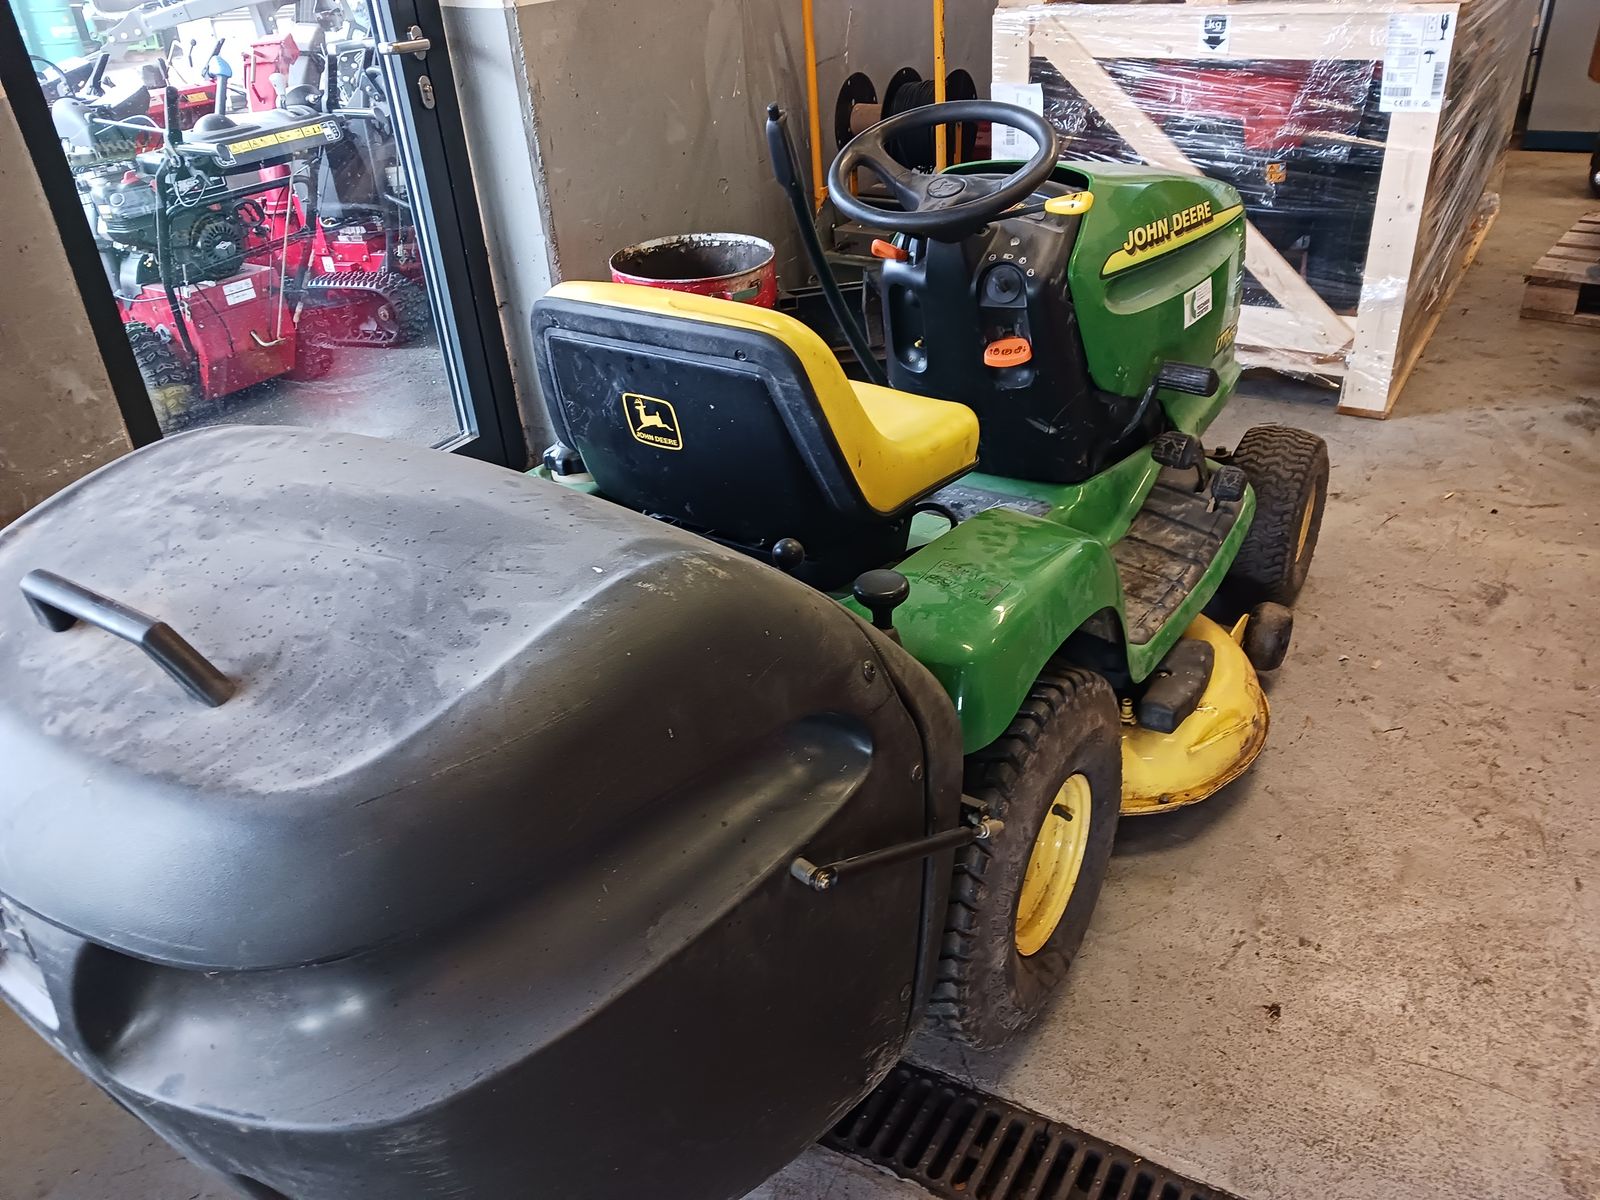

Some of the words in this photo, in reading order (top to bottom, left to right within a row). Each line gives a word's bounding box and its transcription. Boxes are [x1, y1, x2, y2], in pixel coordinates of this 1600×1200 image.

[1208, 18, 1222, 32] kg
[1123, 217, 1169, 252] JOHN
[1172, 200, 1213, 232] DEERE
[636, 431, 654, 442] JOHN
[654, 435, 679, 446] DEERE
